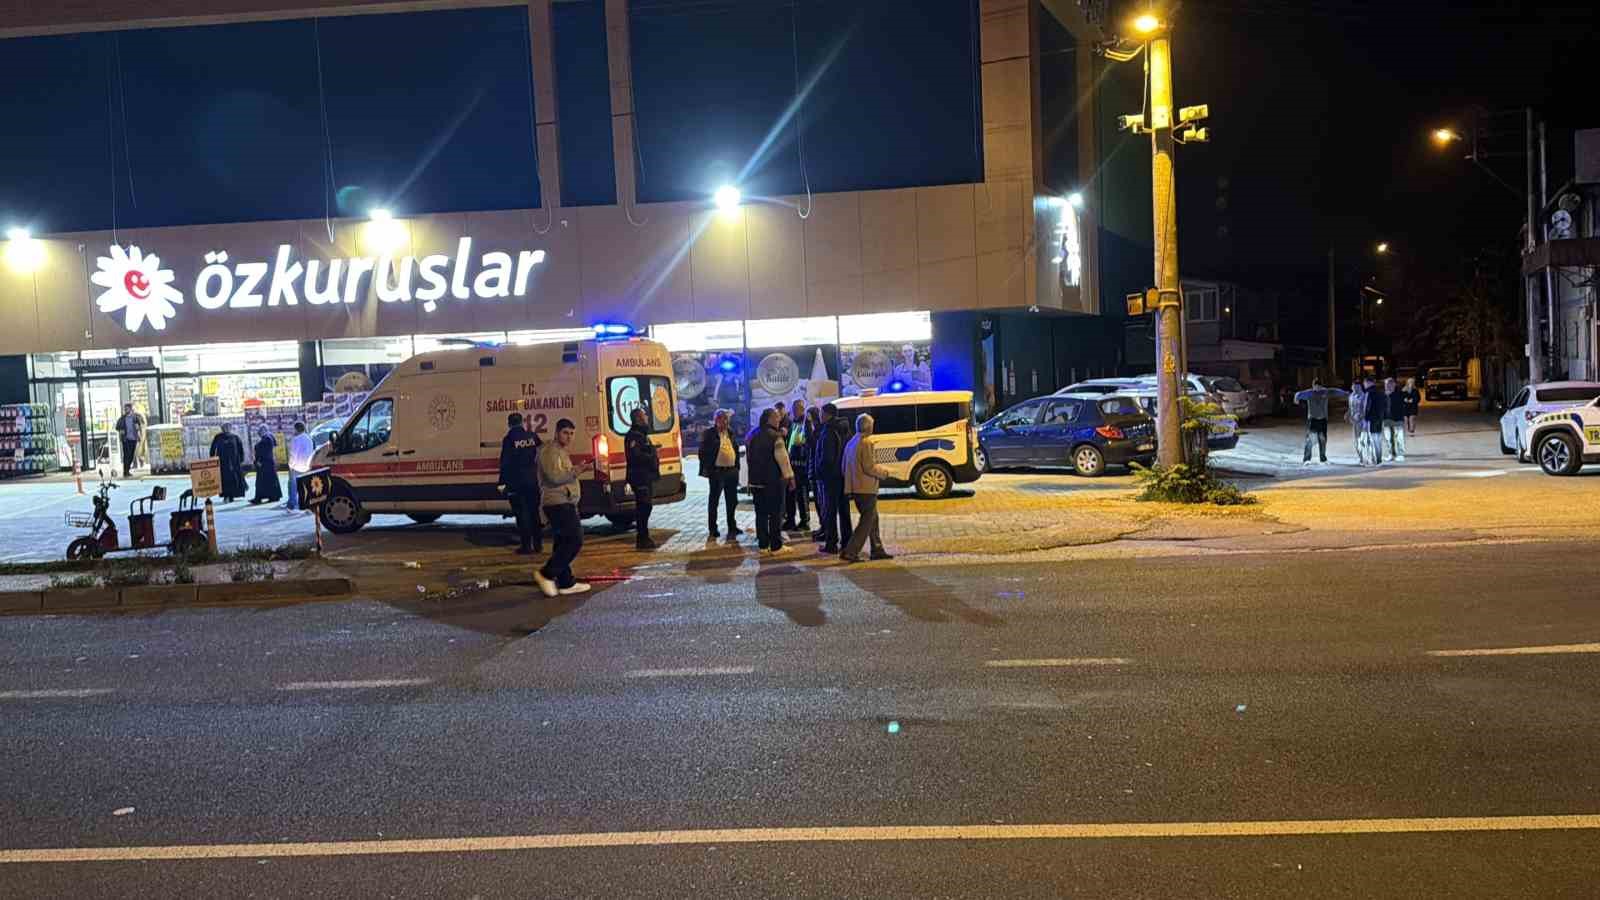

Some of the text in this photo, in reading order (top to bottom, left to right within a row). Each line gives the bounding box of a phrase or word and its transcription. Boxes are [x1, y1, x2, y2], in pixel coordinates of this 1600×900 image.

[195, 236, 546, 313] özkuruşlar
[616, 358, 661, 367] AMBULANS
[521, 384, 537, 395] T.C.
[523, 395, 574, 410] BAKANLIĞI
[523, 413, 548, 433] 12
[1589, 429, 1600, 441] TR
[416, 459, 464, 473] AMBULANS
